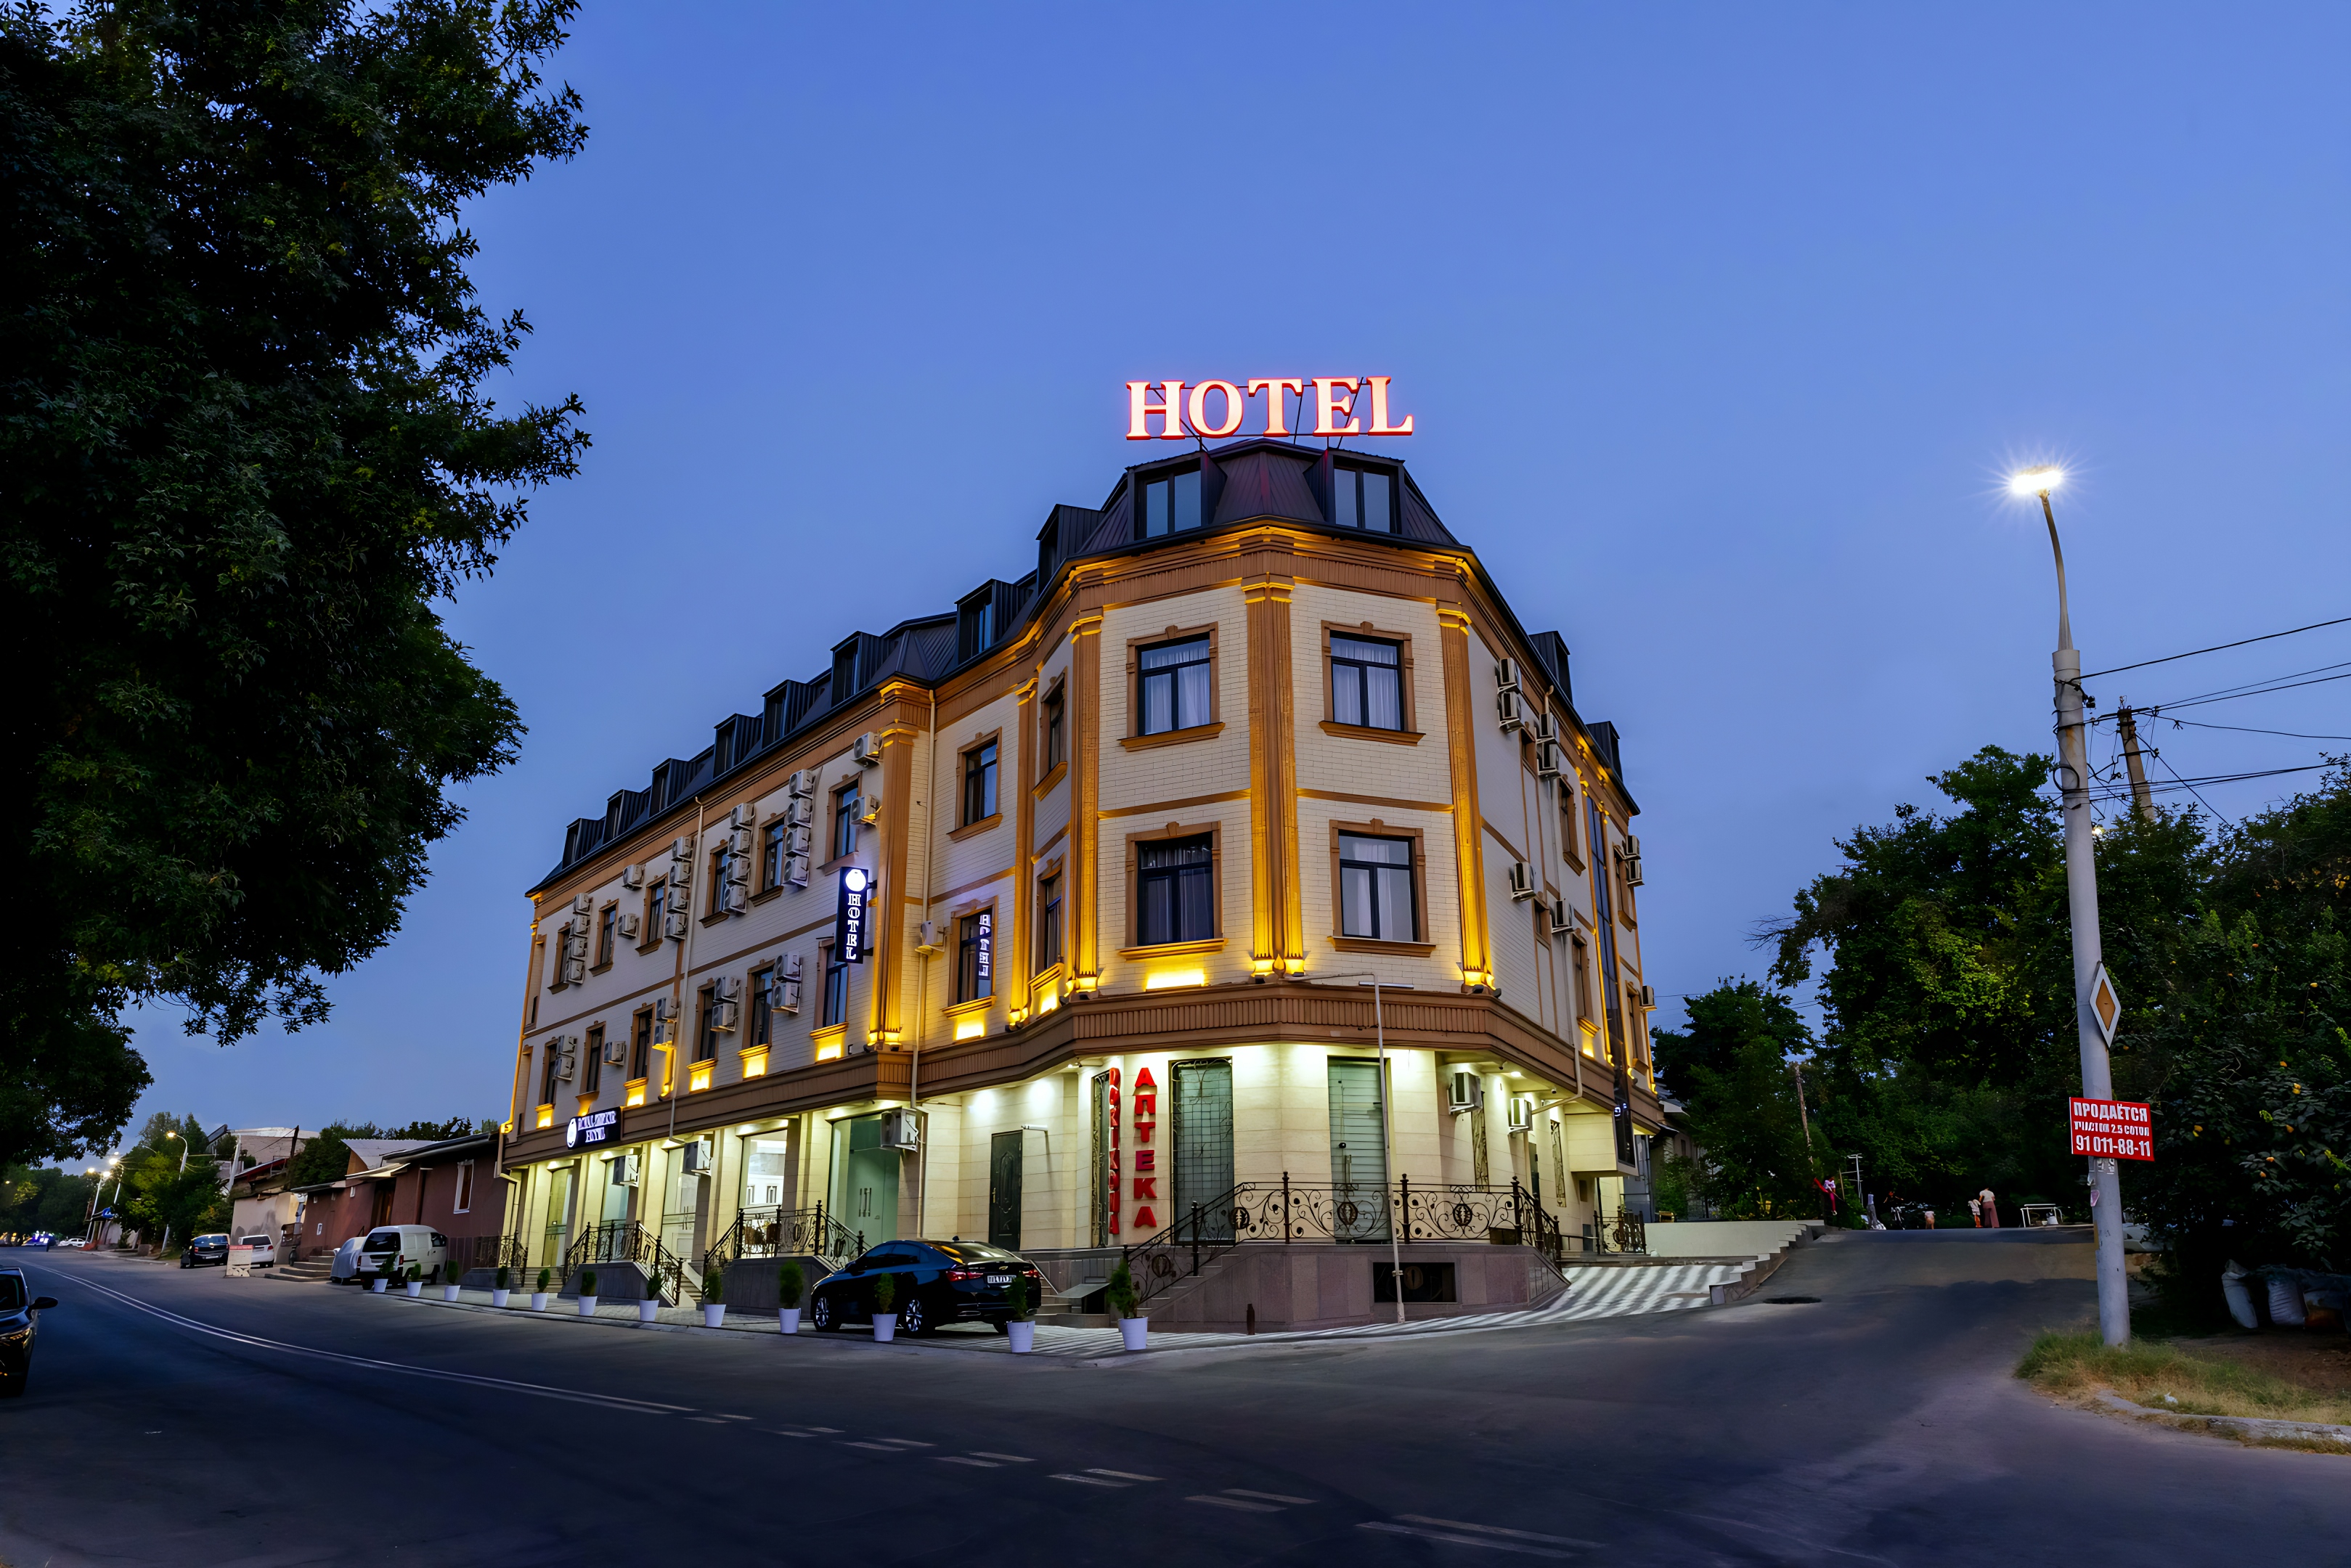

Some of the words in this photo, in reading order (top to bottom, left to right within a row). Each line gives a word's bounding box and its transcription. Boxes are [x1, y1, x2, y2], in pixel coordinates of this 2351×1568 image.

[1126, 376, 1413, 440] HOTEL
[846, 894, 861, 960] HOTEL
[2074, 1102, 2148, 1122] ПРОДАЁТСЯ
[1134, 1067, 1157, 1228] АПТЕКА
[2076, 1135, 2090, 1151] 91
[2093, 1136, 2151, 1156] 011-88-11
